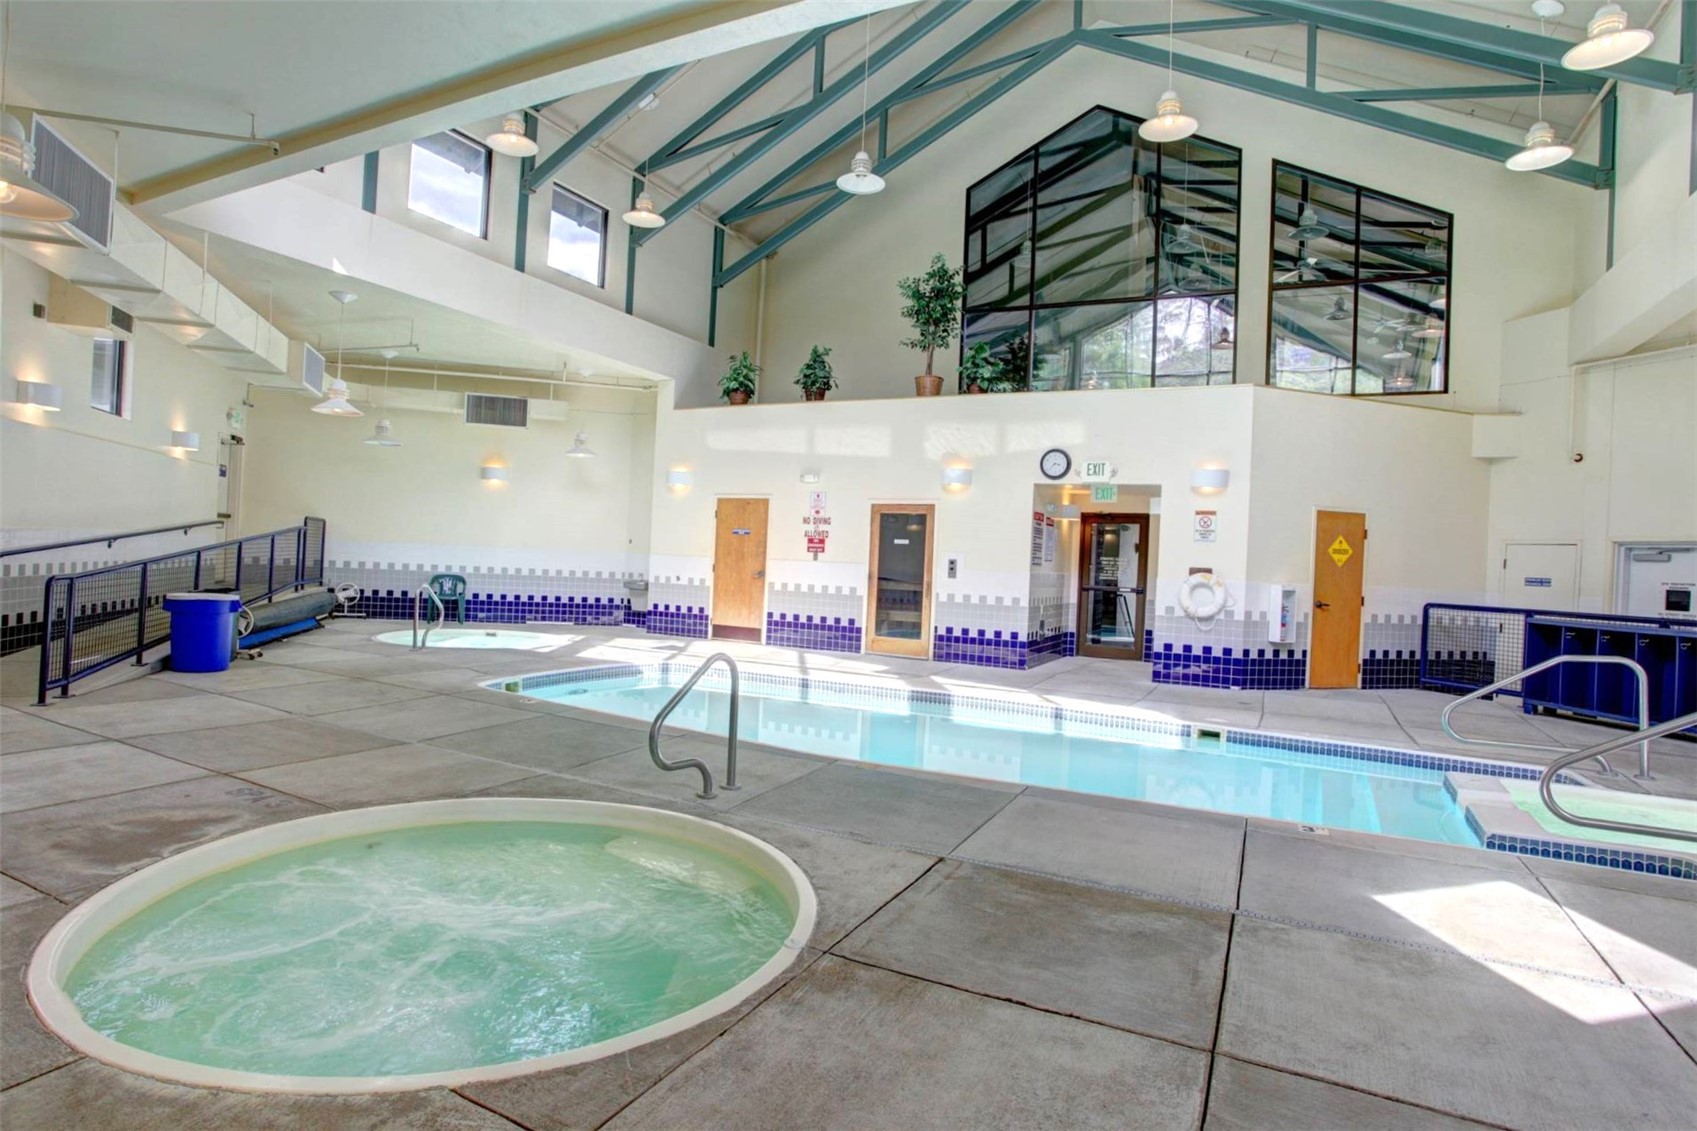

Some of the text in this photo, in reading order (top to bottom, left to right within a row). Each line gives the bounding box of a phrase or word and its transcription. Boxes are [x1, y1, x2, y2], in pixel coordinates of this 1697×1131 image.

[1086, 462, 1106, 476] EXIT
[1095, 486, 1113, 500] EXIT
[802, 517, 831, 525] NO DIVING
[804, 530, 829, 538] ALLOWED
